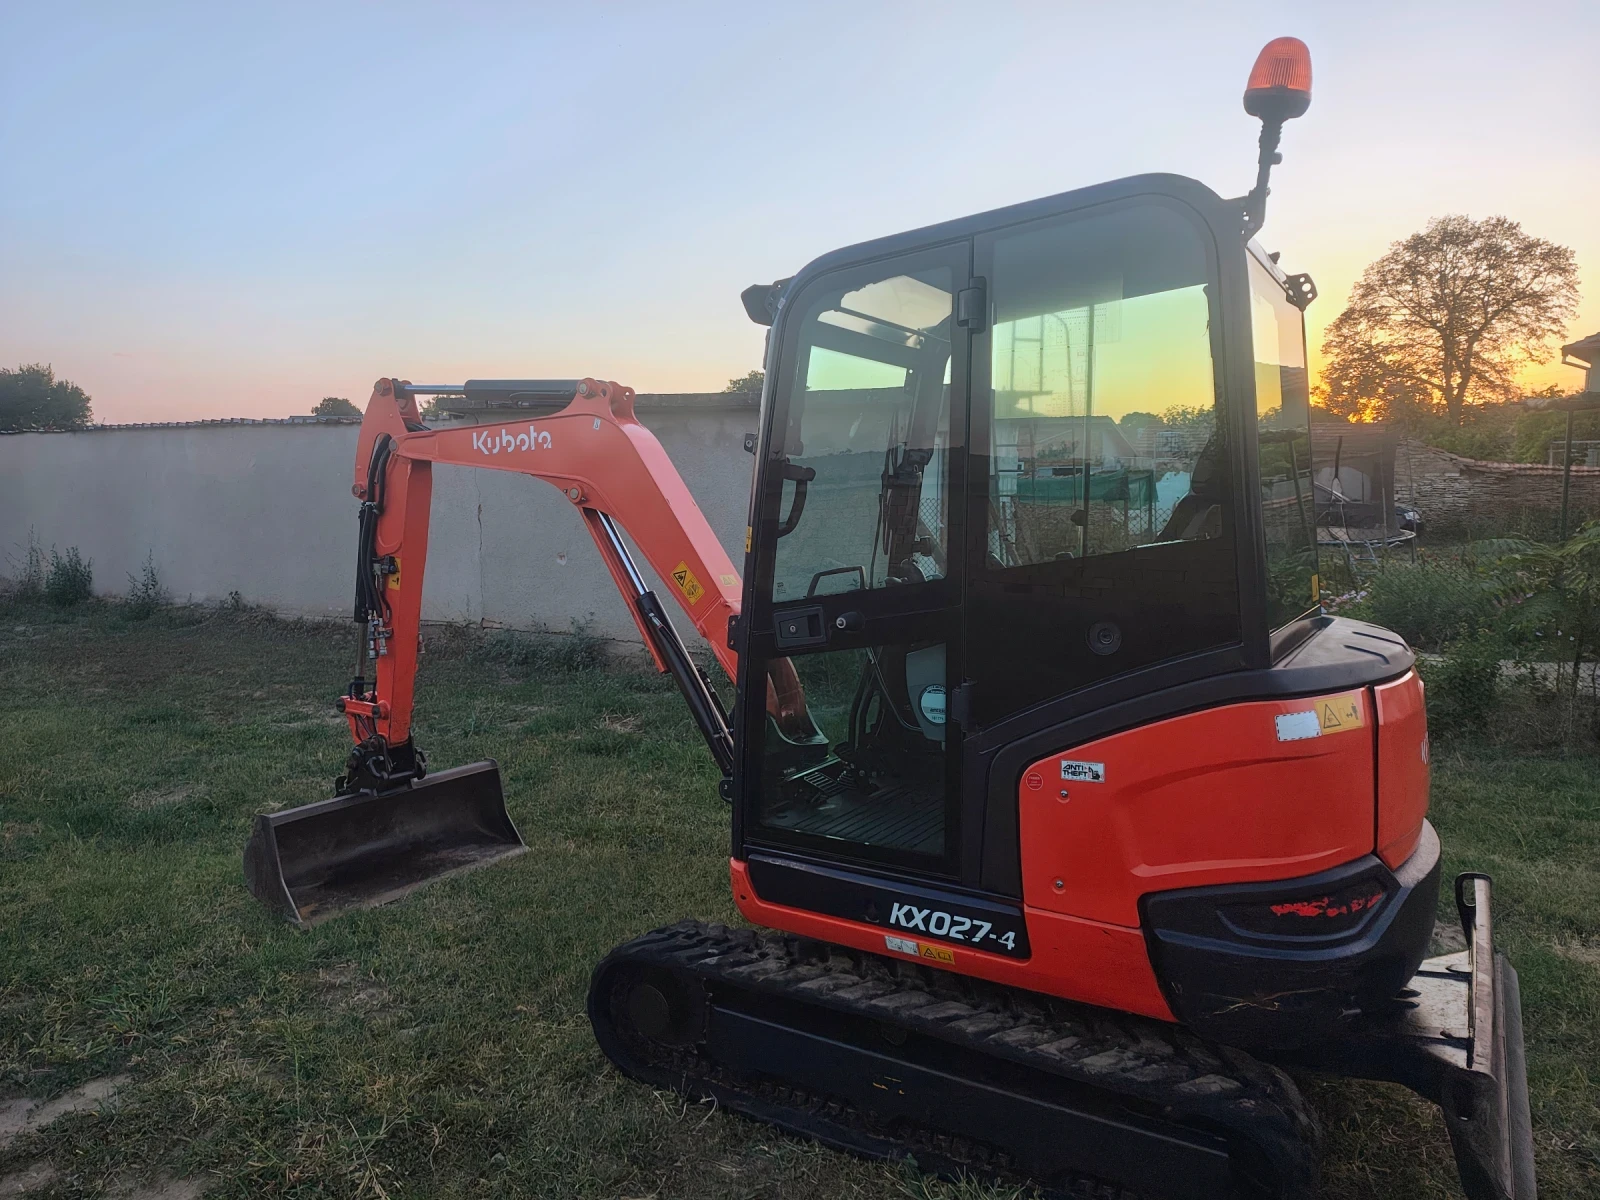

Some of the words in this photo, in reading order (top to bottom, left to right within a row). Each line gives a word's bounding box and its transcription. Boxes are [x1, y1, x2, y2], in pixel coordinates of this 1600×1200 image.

[472, 425, 552, 455] Kubota
[1062, 769, 1089, 778] THEFT
[889, 902, 1016, 951] KX027-4
